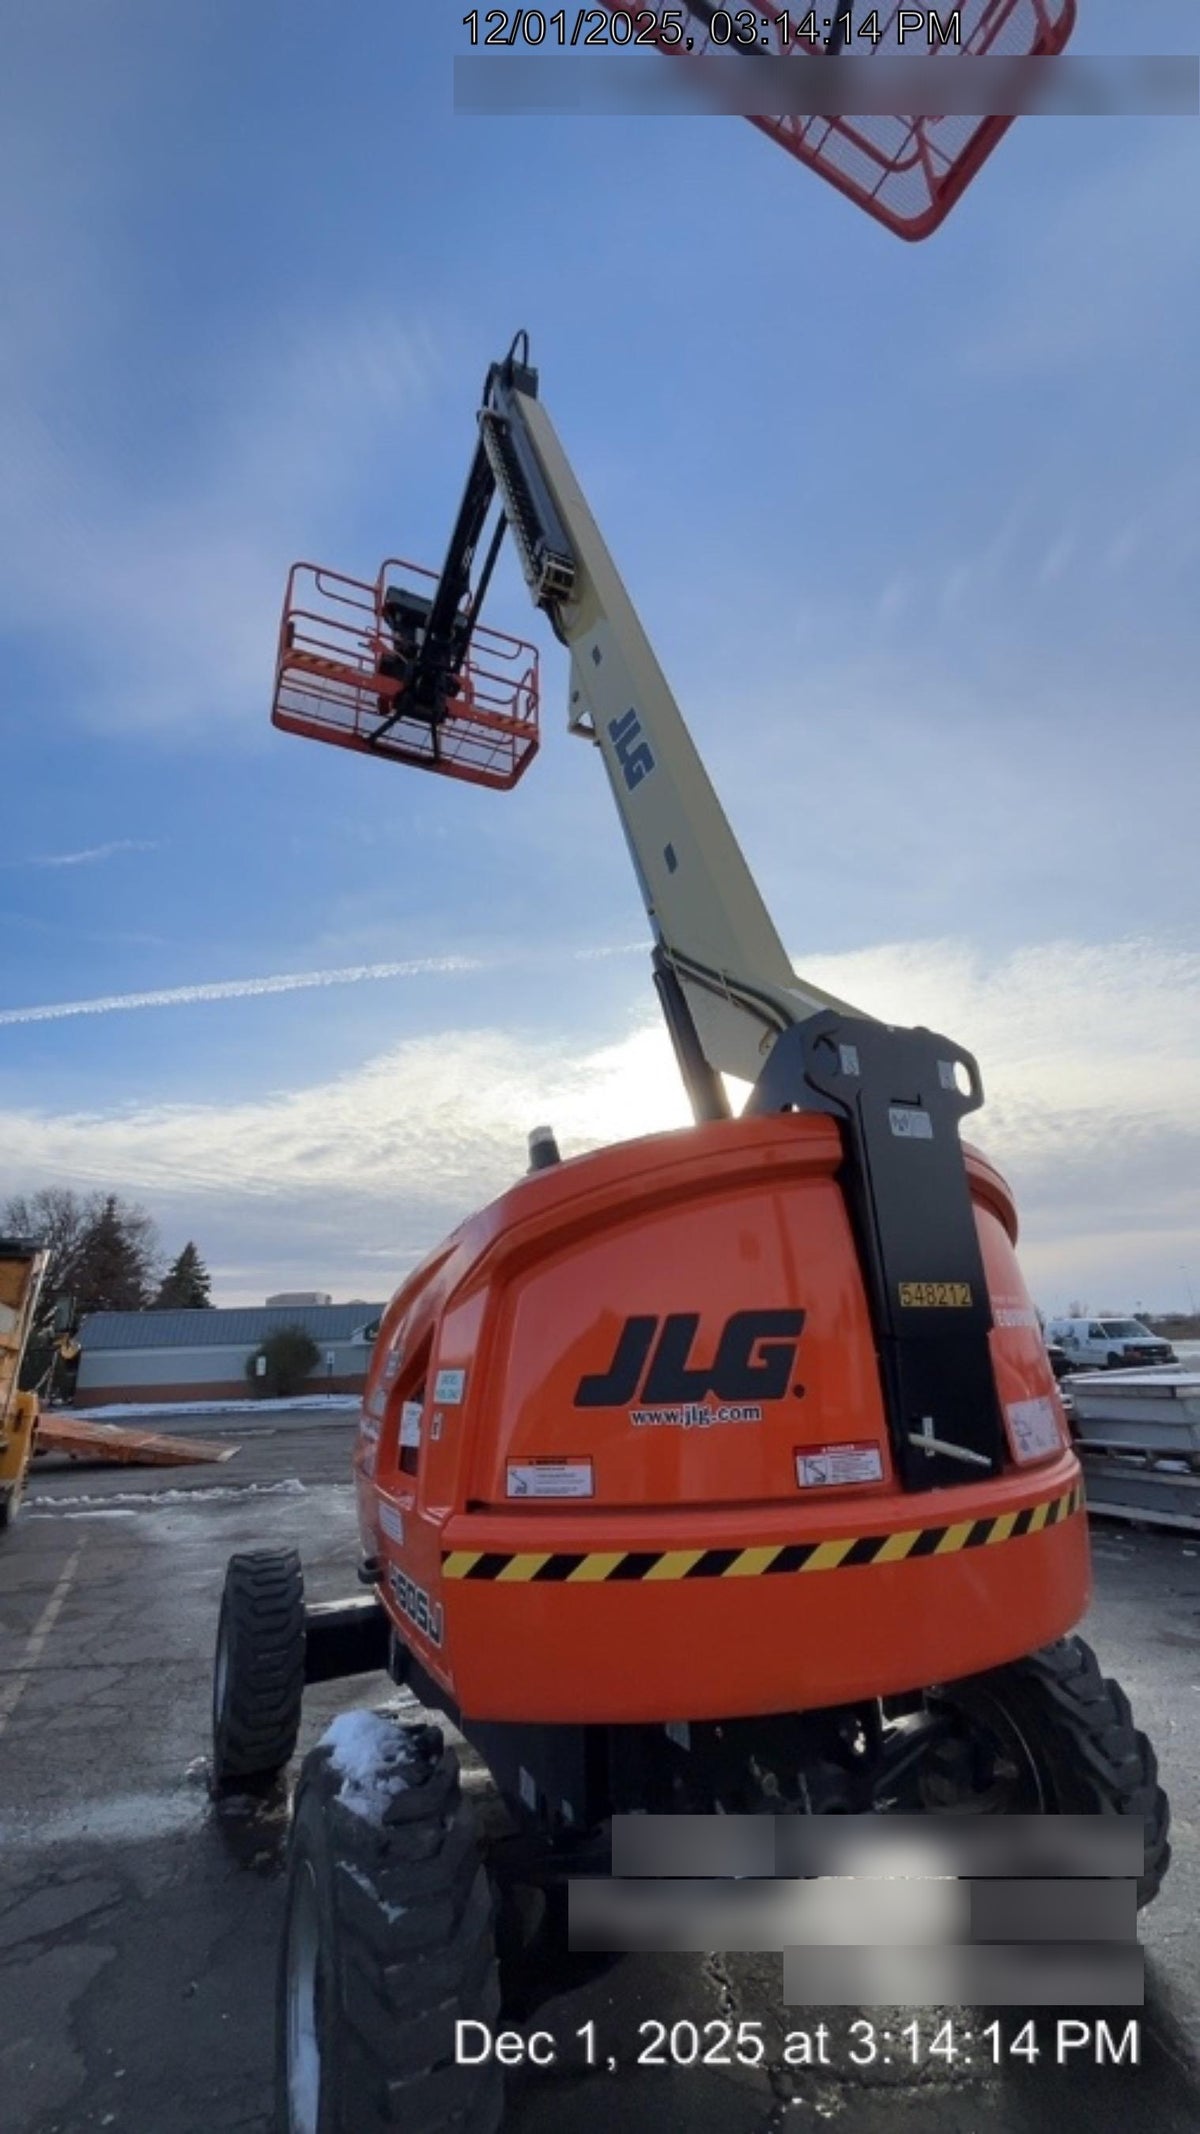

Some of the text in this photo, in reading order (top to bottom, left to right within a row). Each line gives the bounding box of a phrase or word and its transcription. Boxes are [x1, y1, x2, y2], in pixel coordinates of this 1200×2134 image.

[607, 707, 655, 791] JLG
[902, 1284, 973, 1304] 548212
[629, 1404, 762, 1428] www.jlg.com
